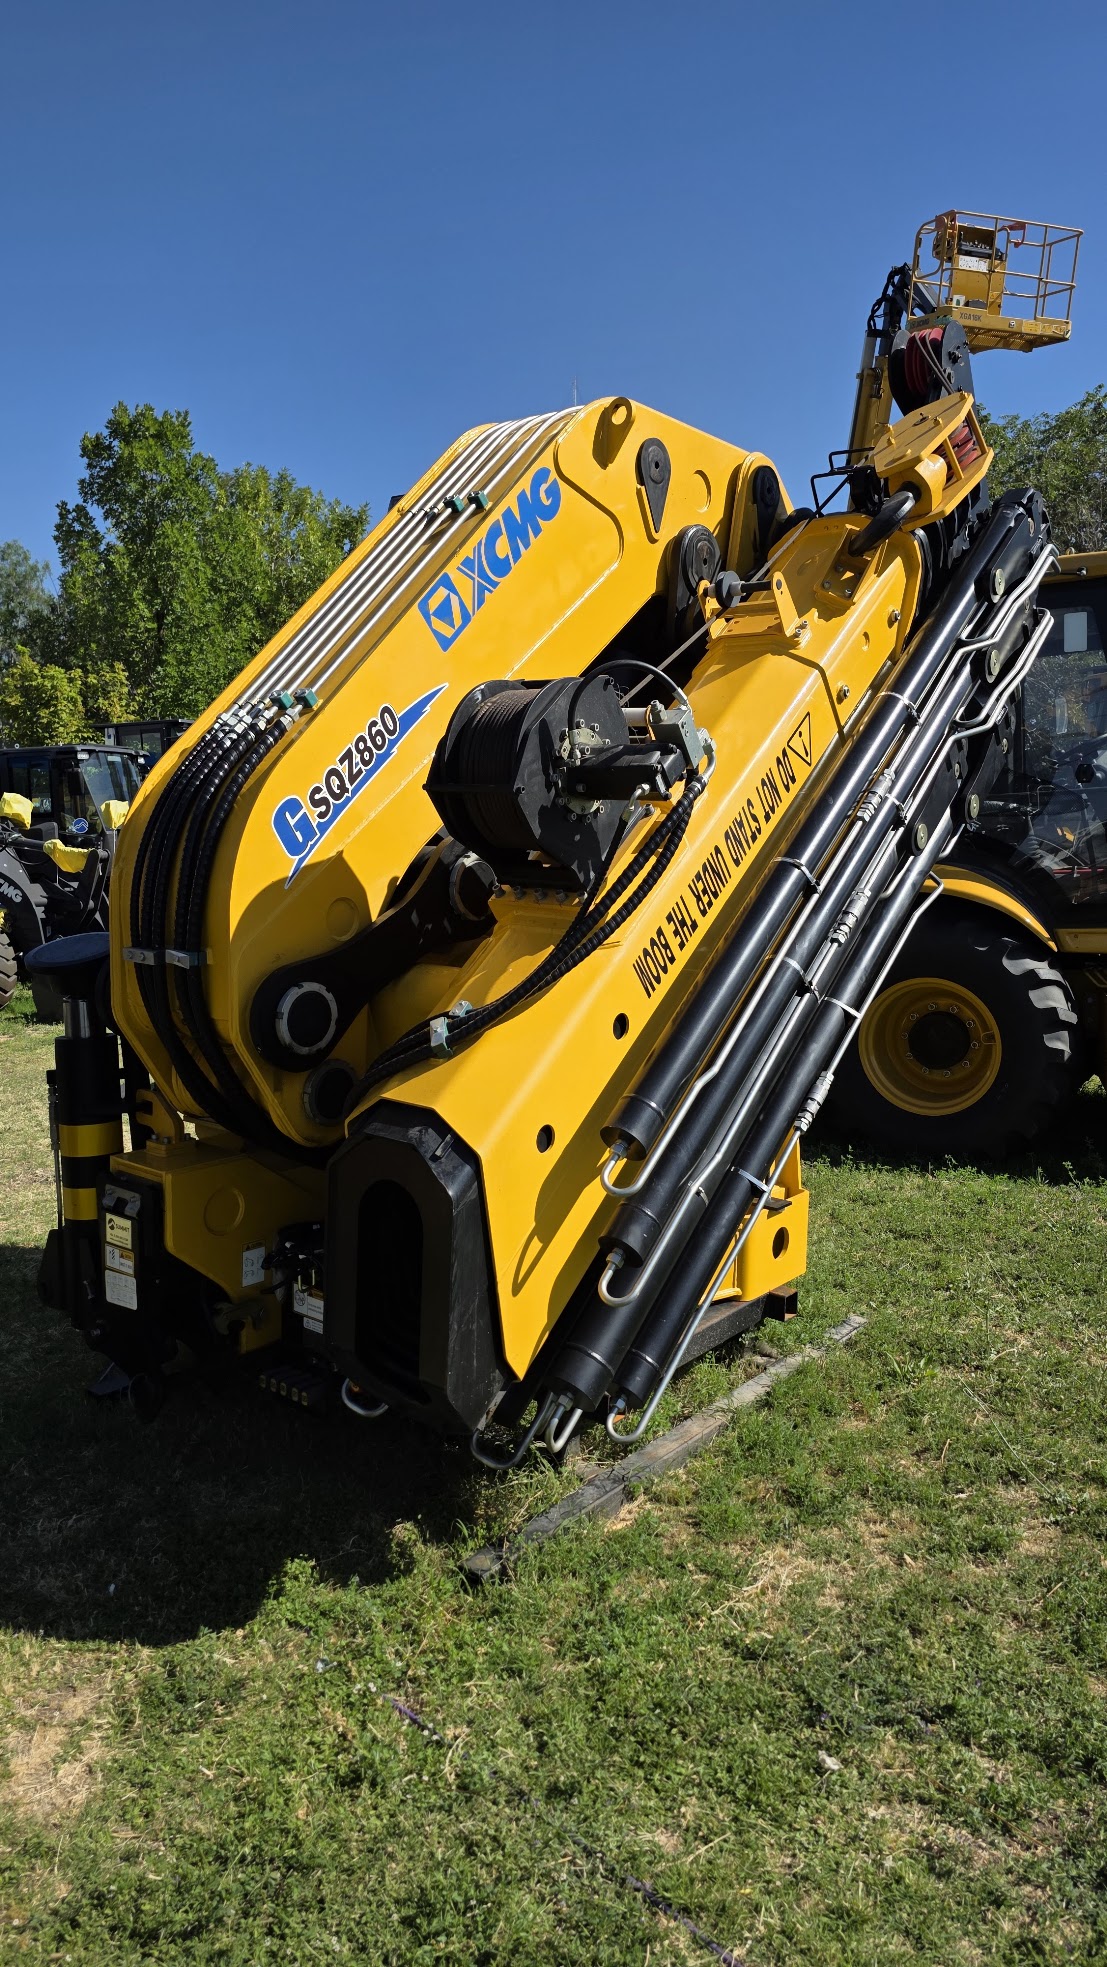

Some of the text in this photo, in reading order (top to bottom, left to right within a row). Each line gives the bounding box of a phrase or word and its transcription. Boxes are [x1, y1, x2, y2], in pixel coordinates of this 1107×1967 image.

[456, 466, 562, 617] XCMG
[632, 746, 797, 999] DO NOT STAND UNDER THE BOOM
